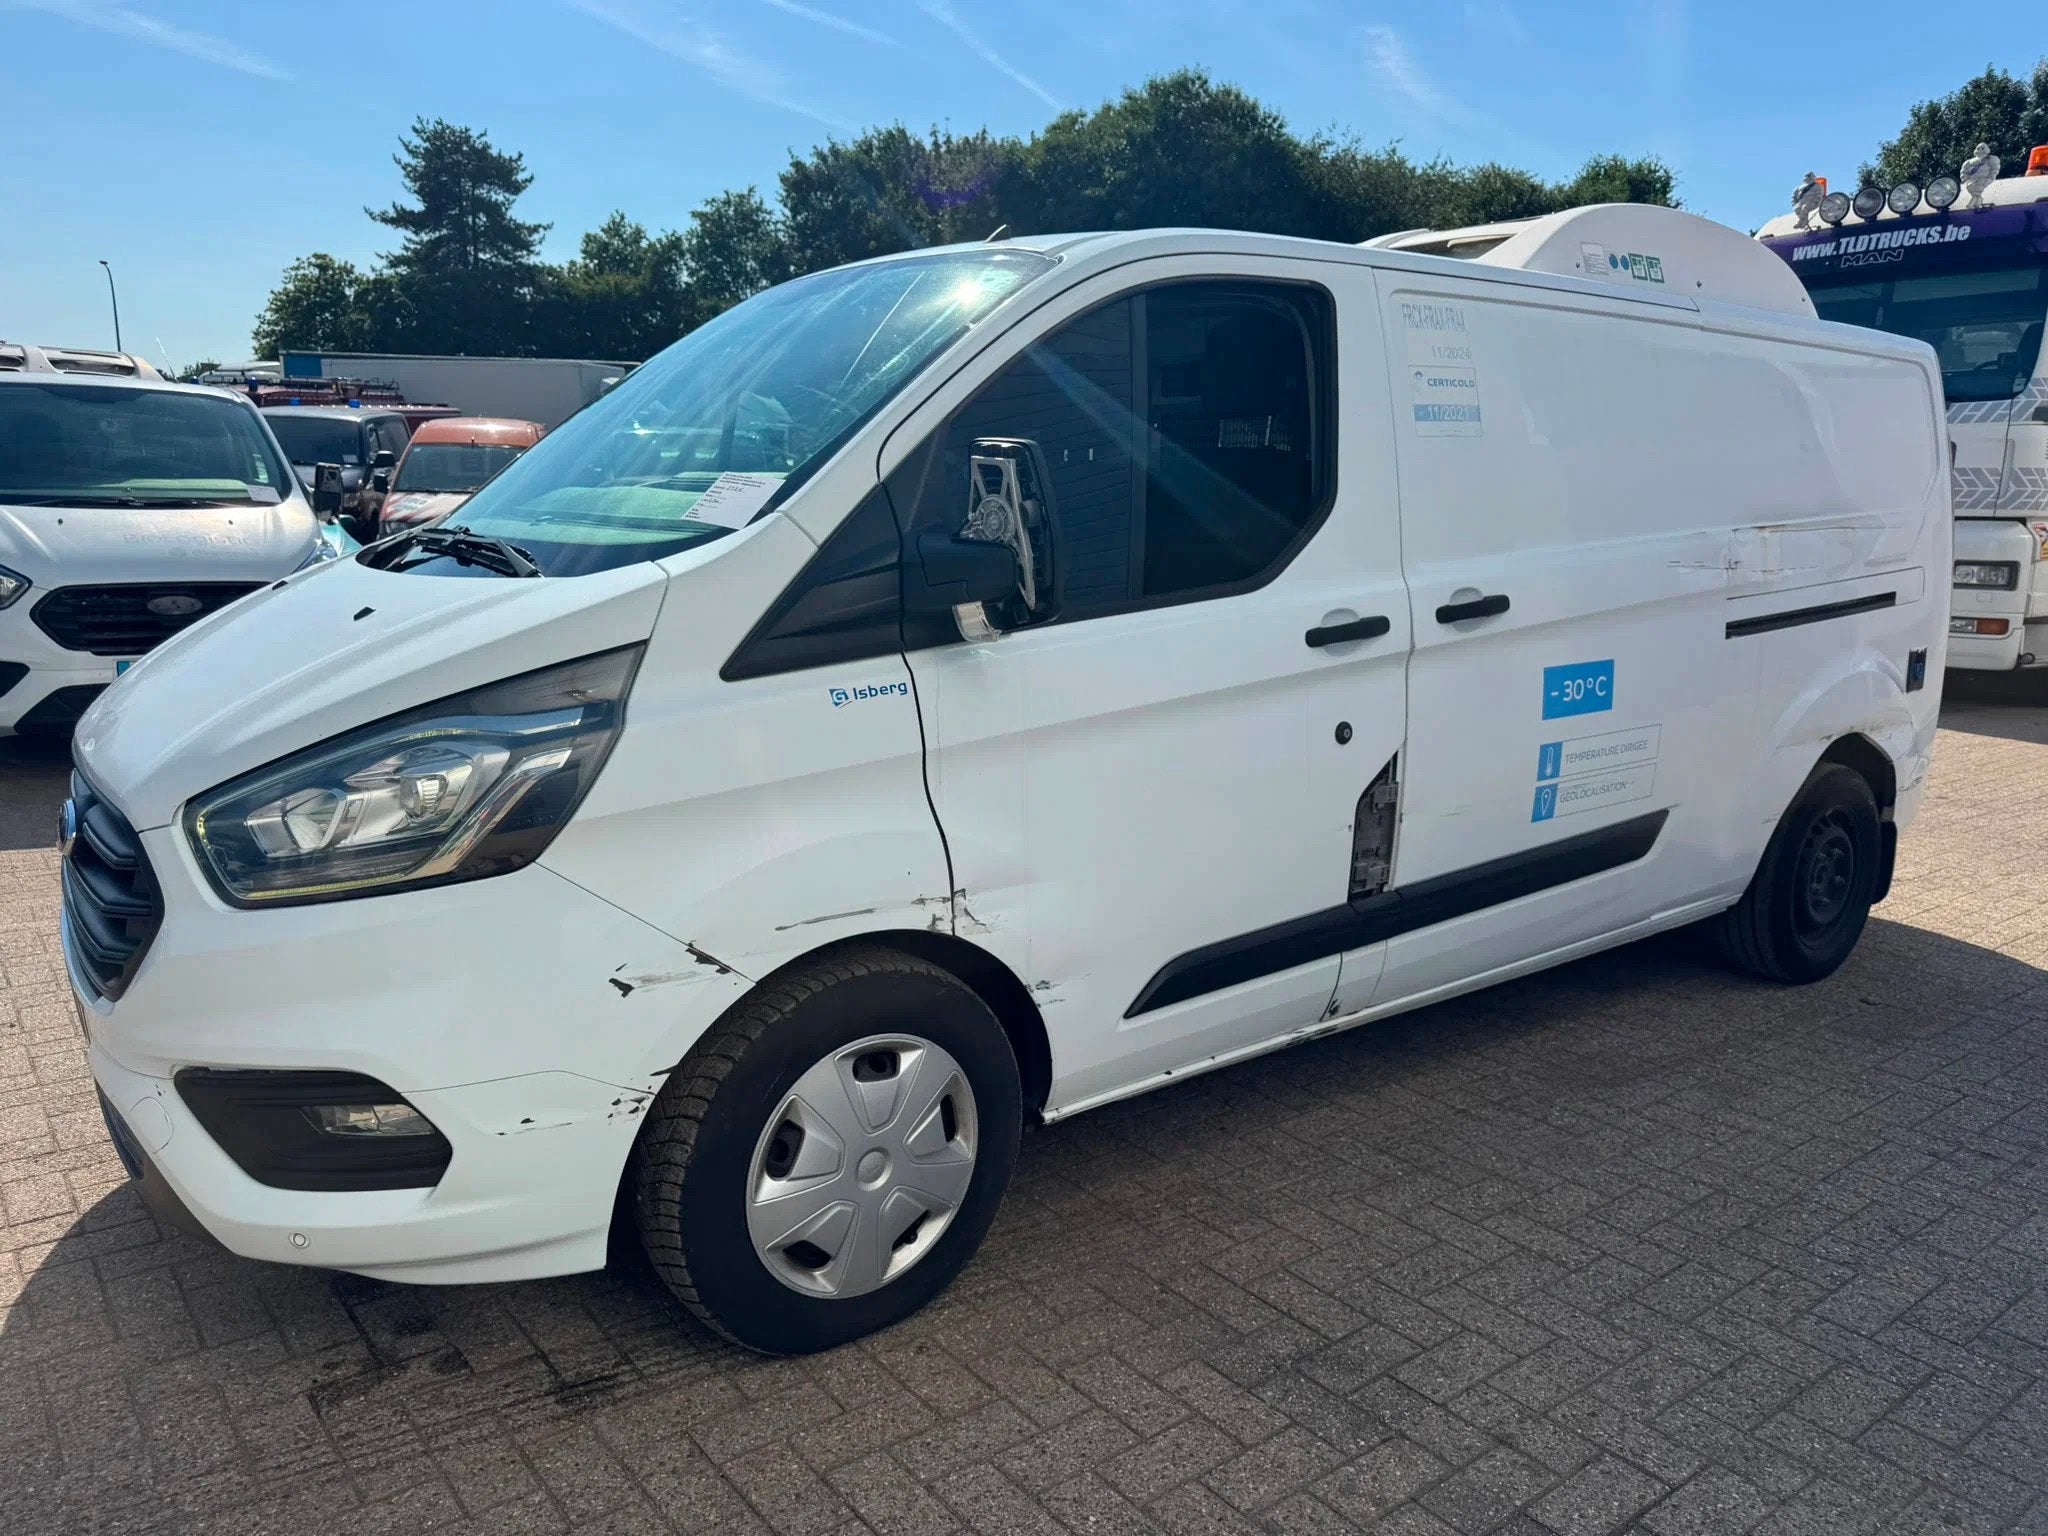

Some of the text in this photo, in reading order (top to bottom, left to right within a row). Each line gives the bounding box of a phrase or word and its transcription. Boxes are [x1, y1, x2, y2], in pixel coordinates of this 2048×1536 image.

[1792, 225, 1971, 261] www.TLDTRUCKS.be
[1840, 249, 1904, 268] MAN
[1427, 378, 1475, 388] CERTICOLD
[1428, 405, 1469, 420] 11/2021
[853, 682, 908, 700] Isberg
